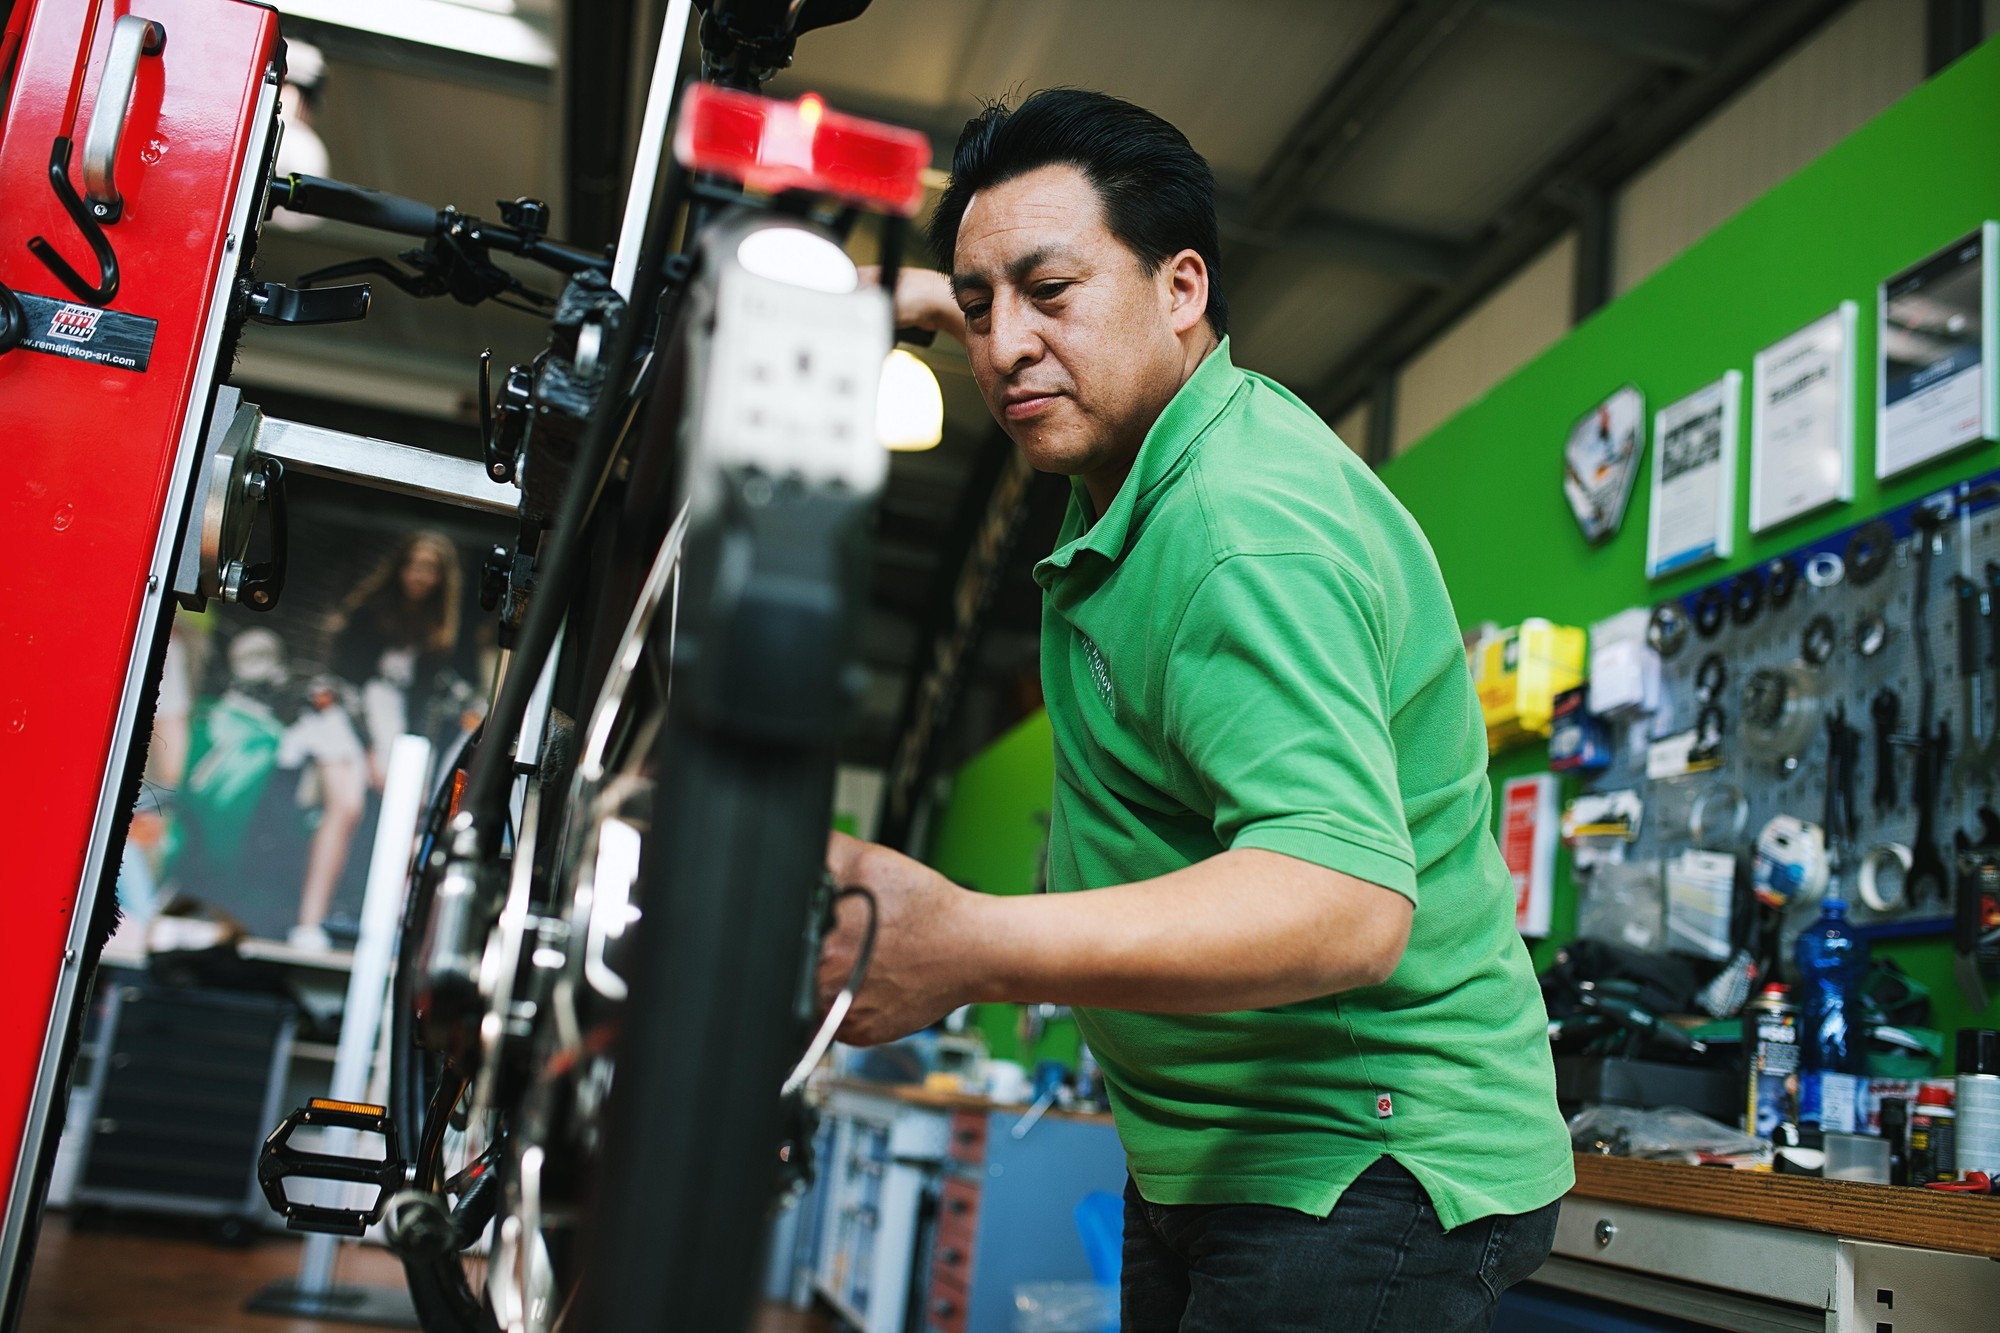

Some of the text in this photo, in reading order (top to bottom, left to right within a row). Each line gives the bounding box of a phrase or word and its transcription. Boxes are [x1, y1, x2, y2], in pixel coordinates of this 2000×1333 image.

[58, 312, 90, 328] TIP
[67, 308, 96, 318] REMA
[59, 323, 92, 338] TOP
[20, 338, 136, 366] w.rematiptop-srl.com
